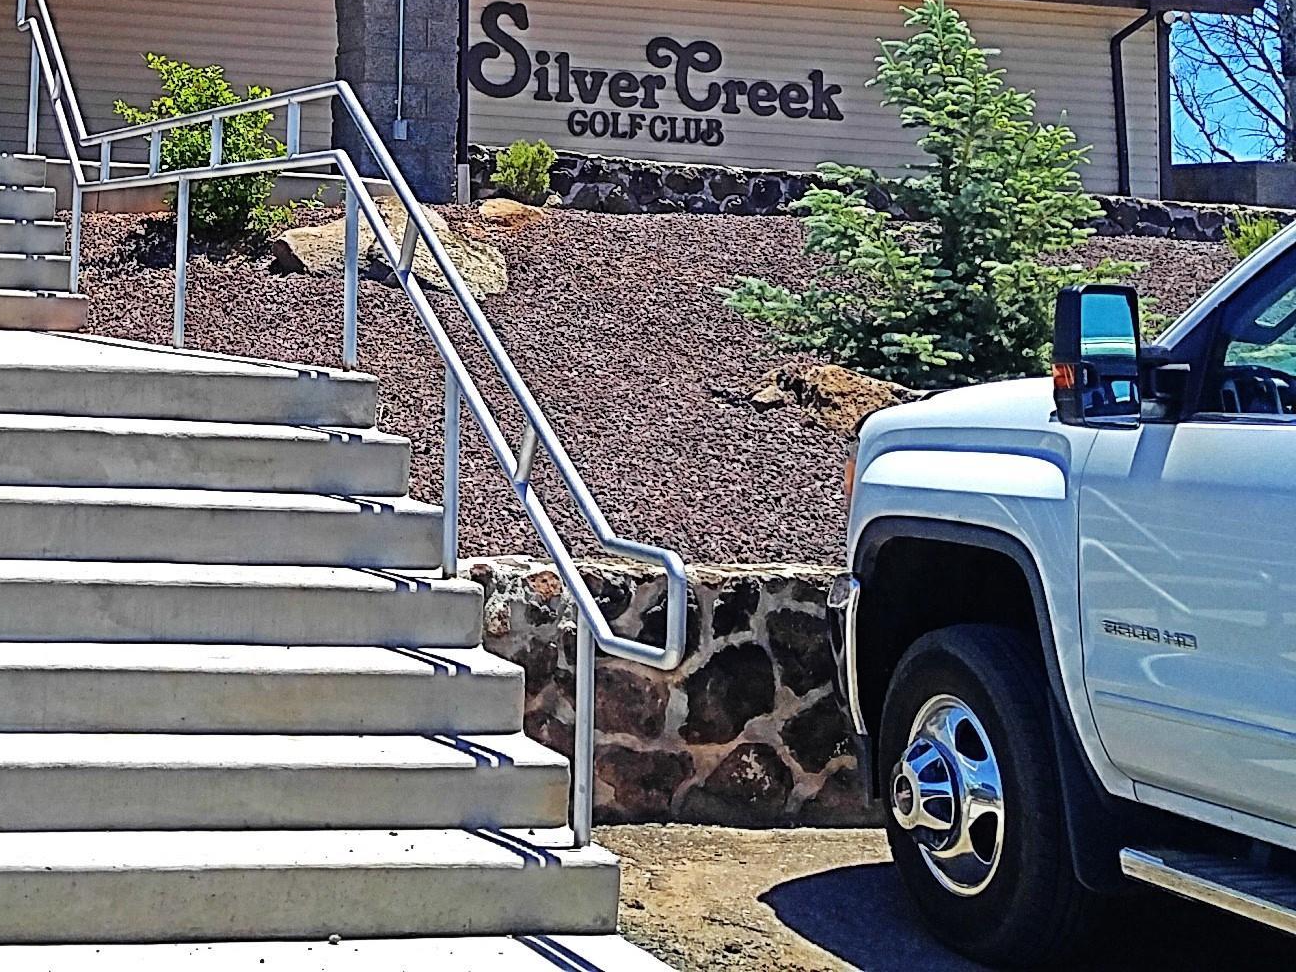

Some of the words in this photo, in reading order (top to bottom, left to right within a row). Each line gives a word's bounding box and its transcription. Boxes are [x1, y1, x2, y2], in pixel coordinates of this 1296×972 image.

[469, 2, 666, 109] Silver
[646, 37, 844, 121] Creek
[568, 110, 645, 139] GOLF
[649, 115, 724, 147] CLUB
